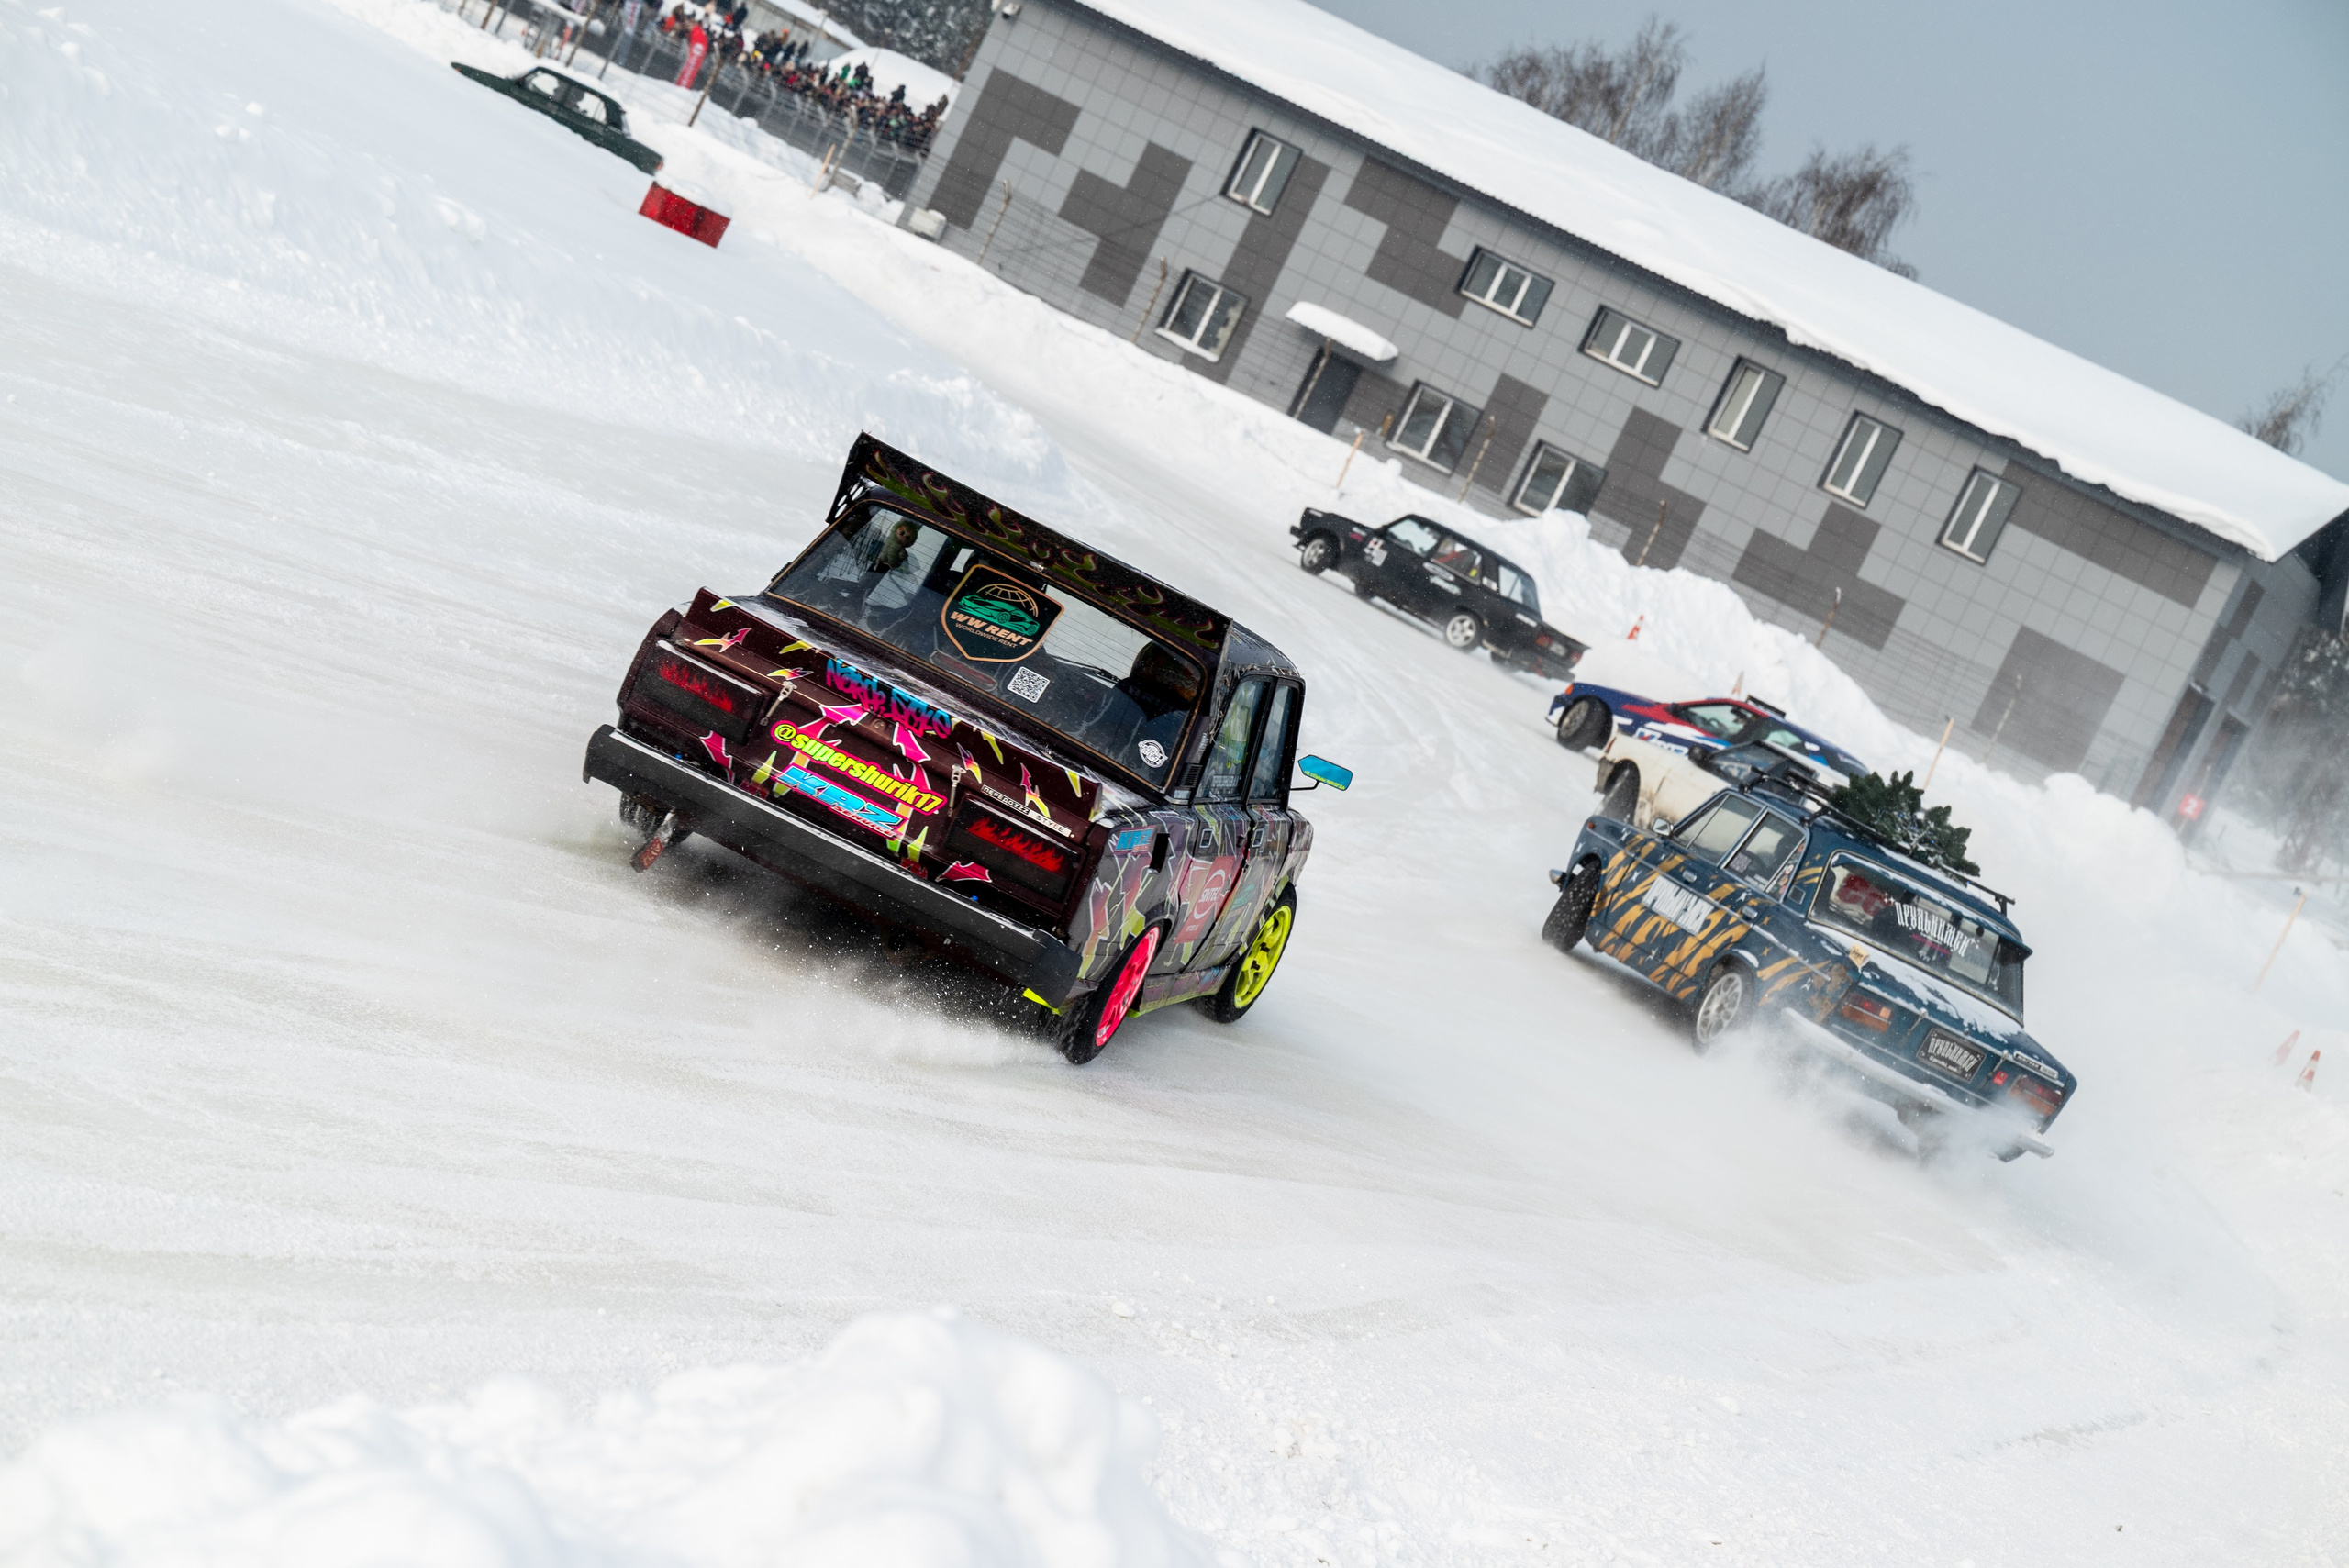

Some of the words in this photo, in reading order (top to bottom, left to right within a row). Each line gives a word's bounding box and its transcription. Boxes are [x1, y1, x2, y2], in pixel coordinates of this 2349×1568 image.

[950, 611, 987, 628] WW
[985, 625, 1033, 646] RENT
[955, 622, 998, 641] WORLDWIDE
[998, 638, 1018, 649] RENT
[774, 723, 943, 813] @supershurik17
[2185, 797, 2198, 816] 2
[1036, 815, 1065, 833] STYLE
[1198, 886, 1221, 903] SINTEC
